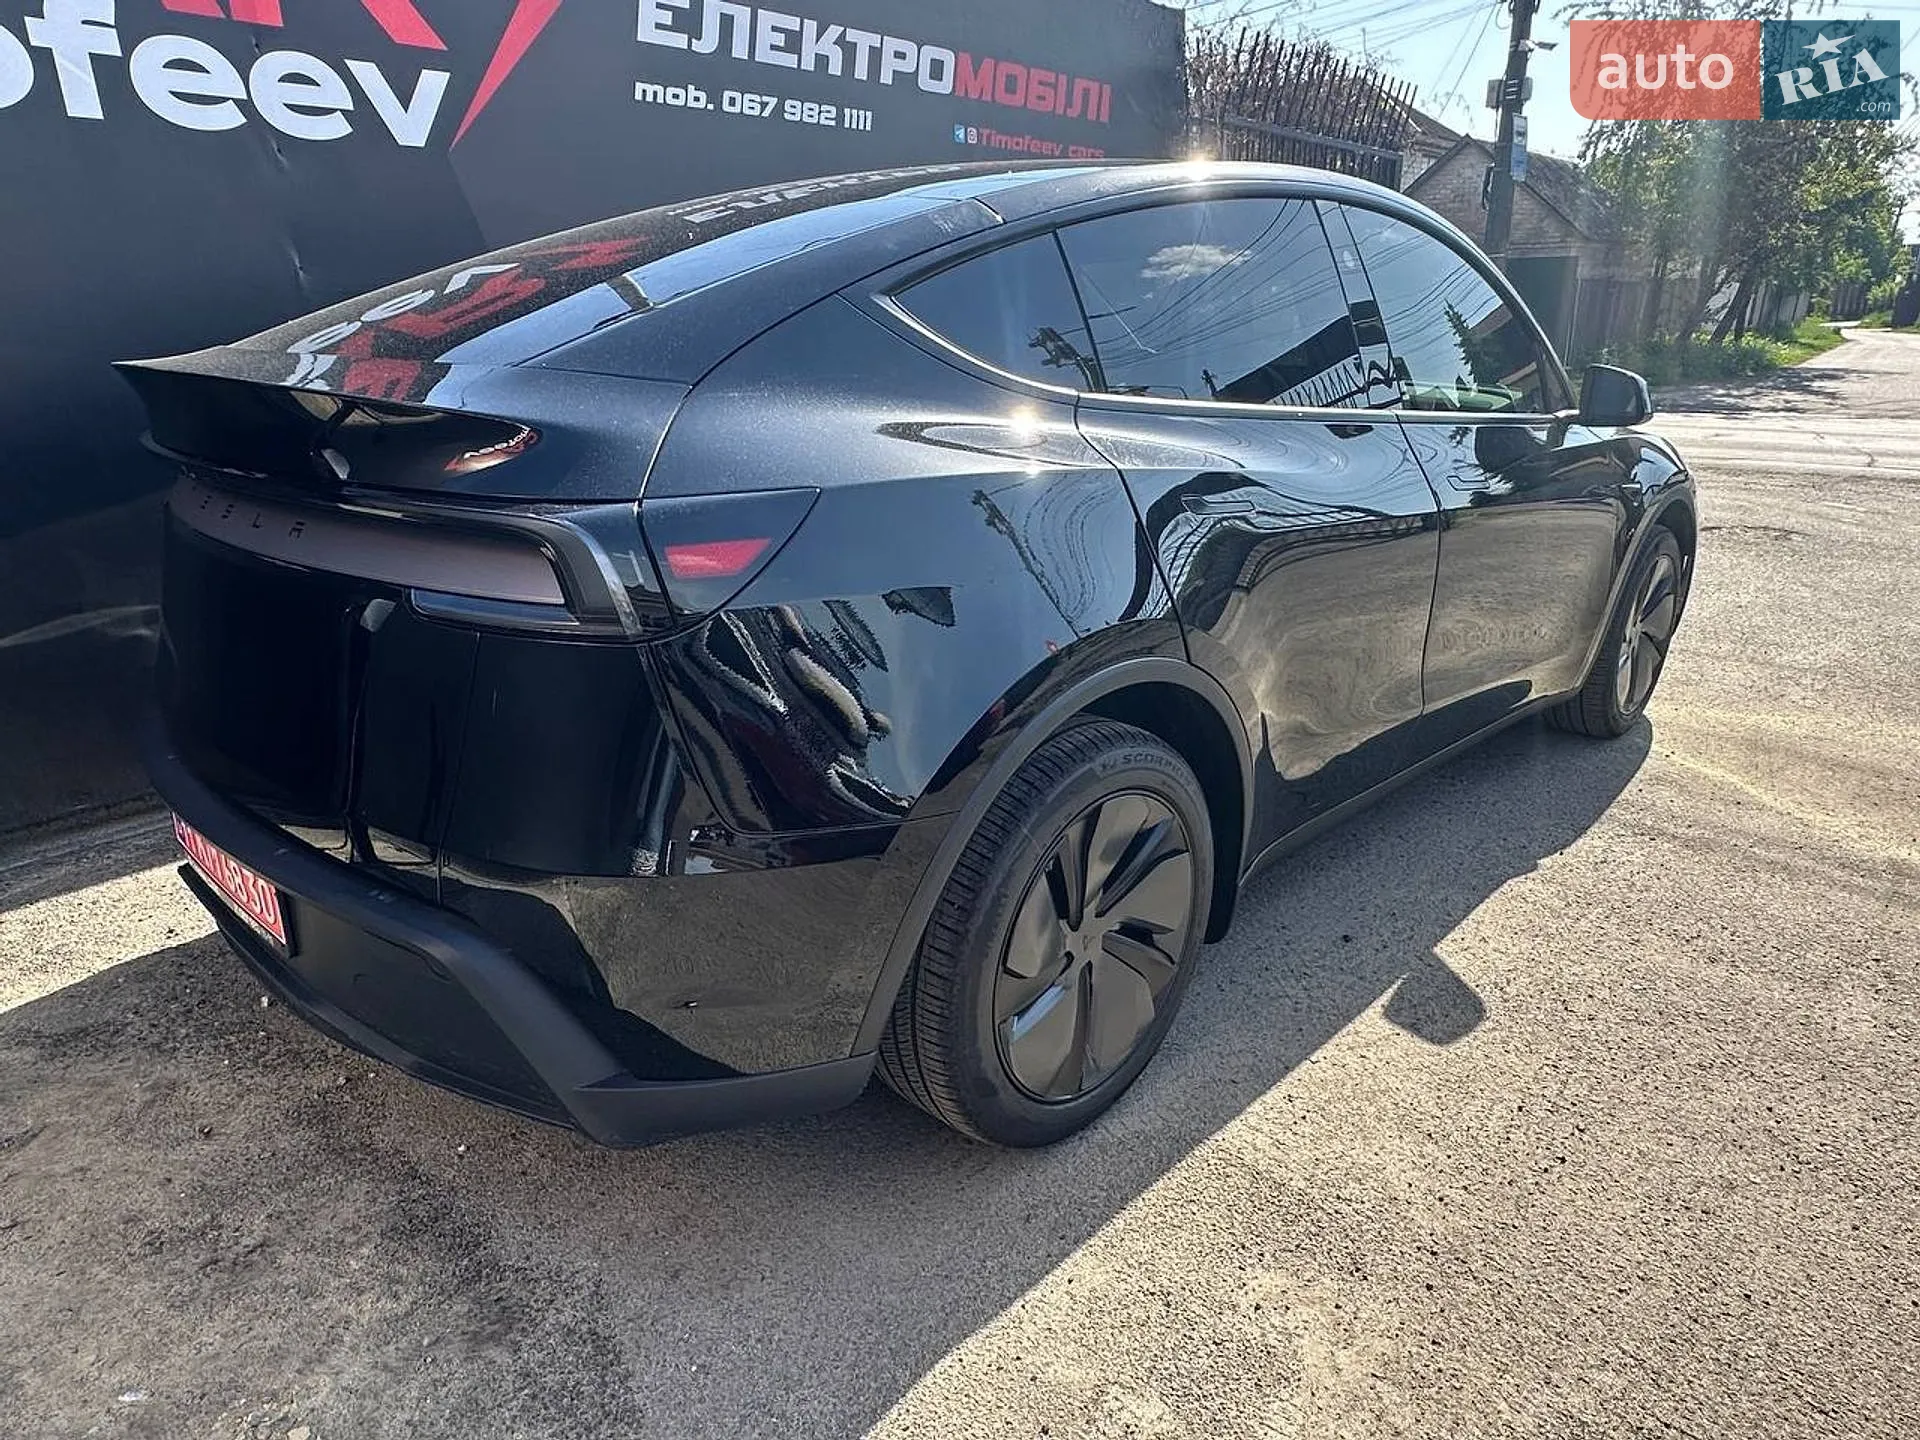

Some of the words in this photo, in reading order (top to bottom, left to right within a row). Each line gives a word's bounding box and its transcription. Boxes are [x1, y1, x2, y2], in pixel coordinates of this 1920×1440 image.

[637, 0, 1112, 123] ЕЛЕКТРОМОБІЛІ
[634, 80, 715, 110] mob.
[722, 90, 778, 117] 067
[784, 99, 837, 126] 982
[844, 108, 872, 131] 1111
[979, 127, 1063, 158] Timofeev
[1067, 145, 1105, 159] cars
